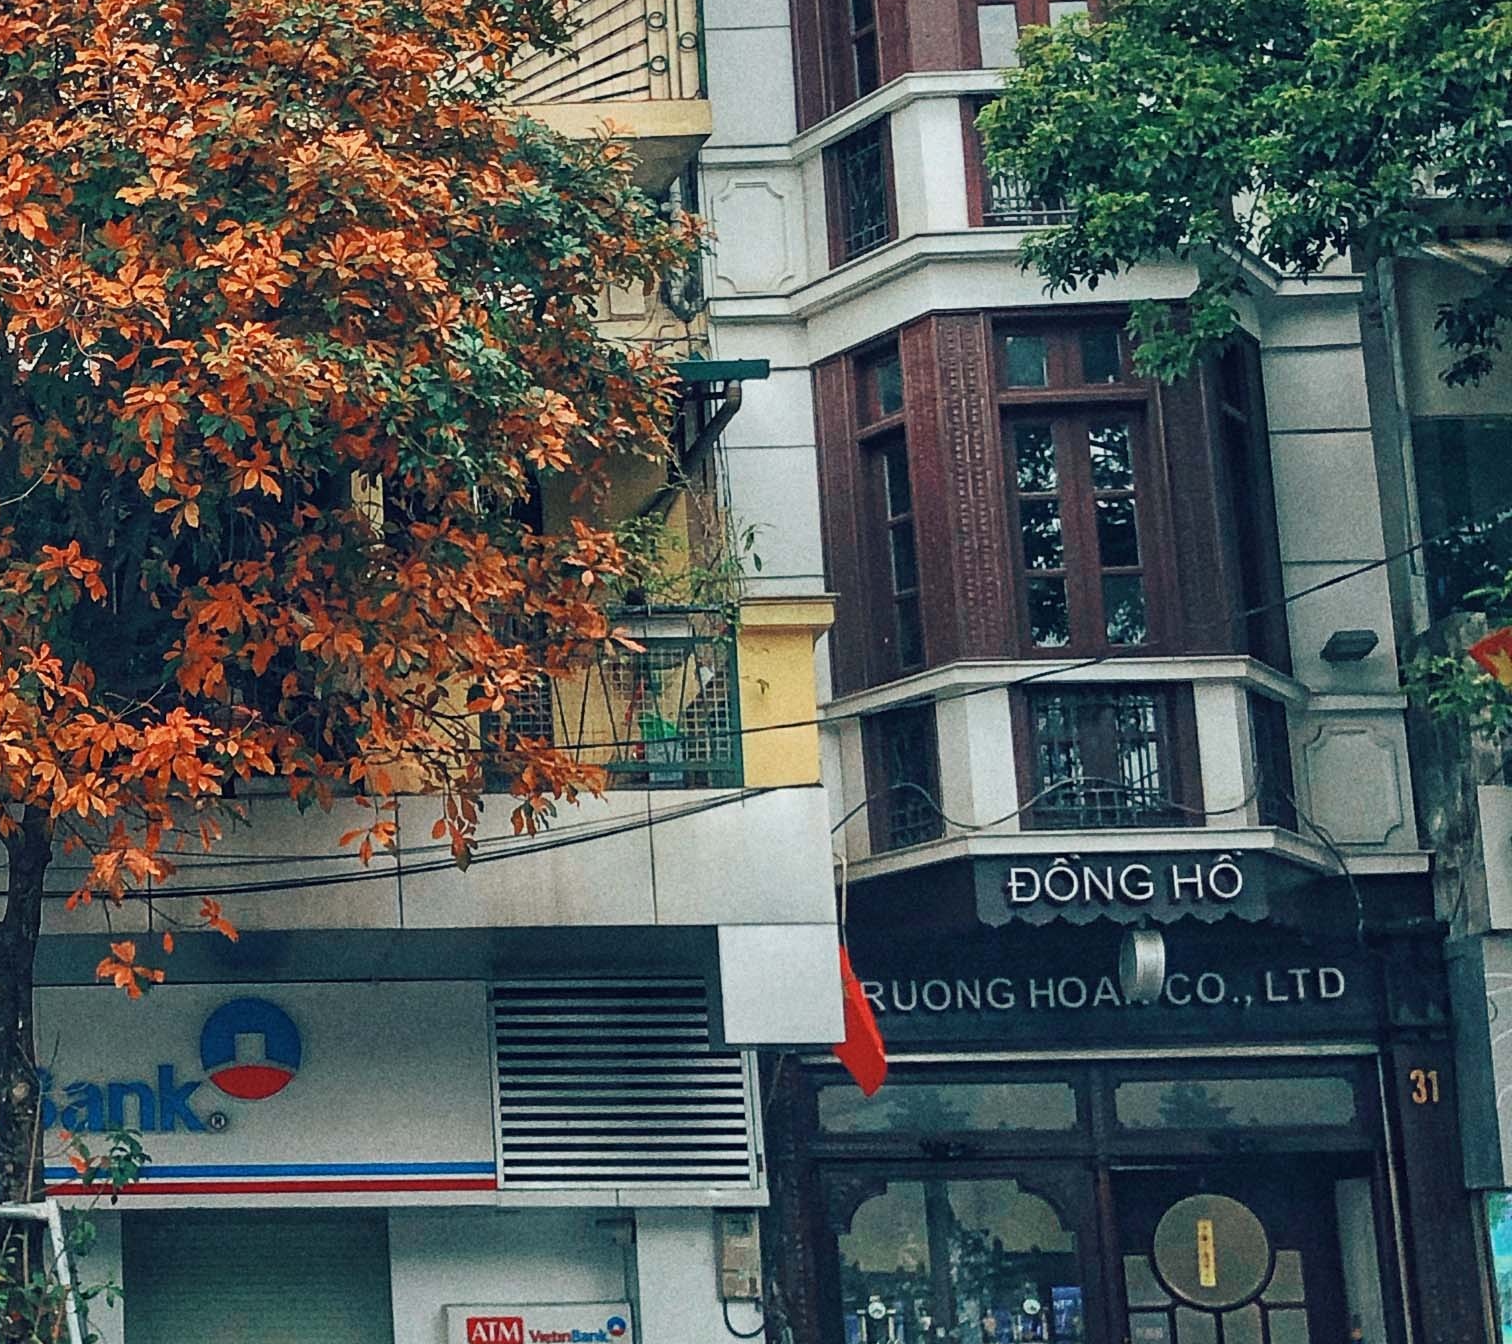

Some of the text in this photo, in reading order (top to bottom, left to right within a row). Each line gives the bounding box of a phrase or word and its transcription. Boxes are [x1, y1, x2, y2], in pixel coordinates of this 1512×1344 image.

[1007, 850, 1244, 903] ĐỒNG HỒ
[859, 977, 1016, 1012] RUONG
[1029, 975, 1150, 1009] HOA
[1265, 967, 1346, 1002] LTD
[1409, 1069, 1440, 1105] 31
[470, 1320, 521, 1343] ATM
